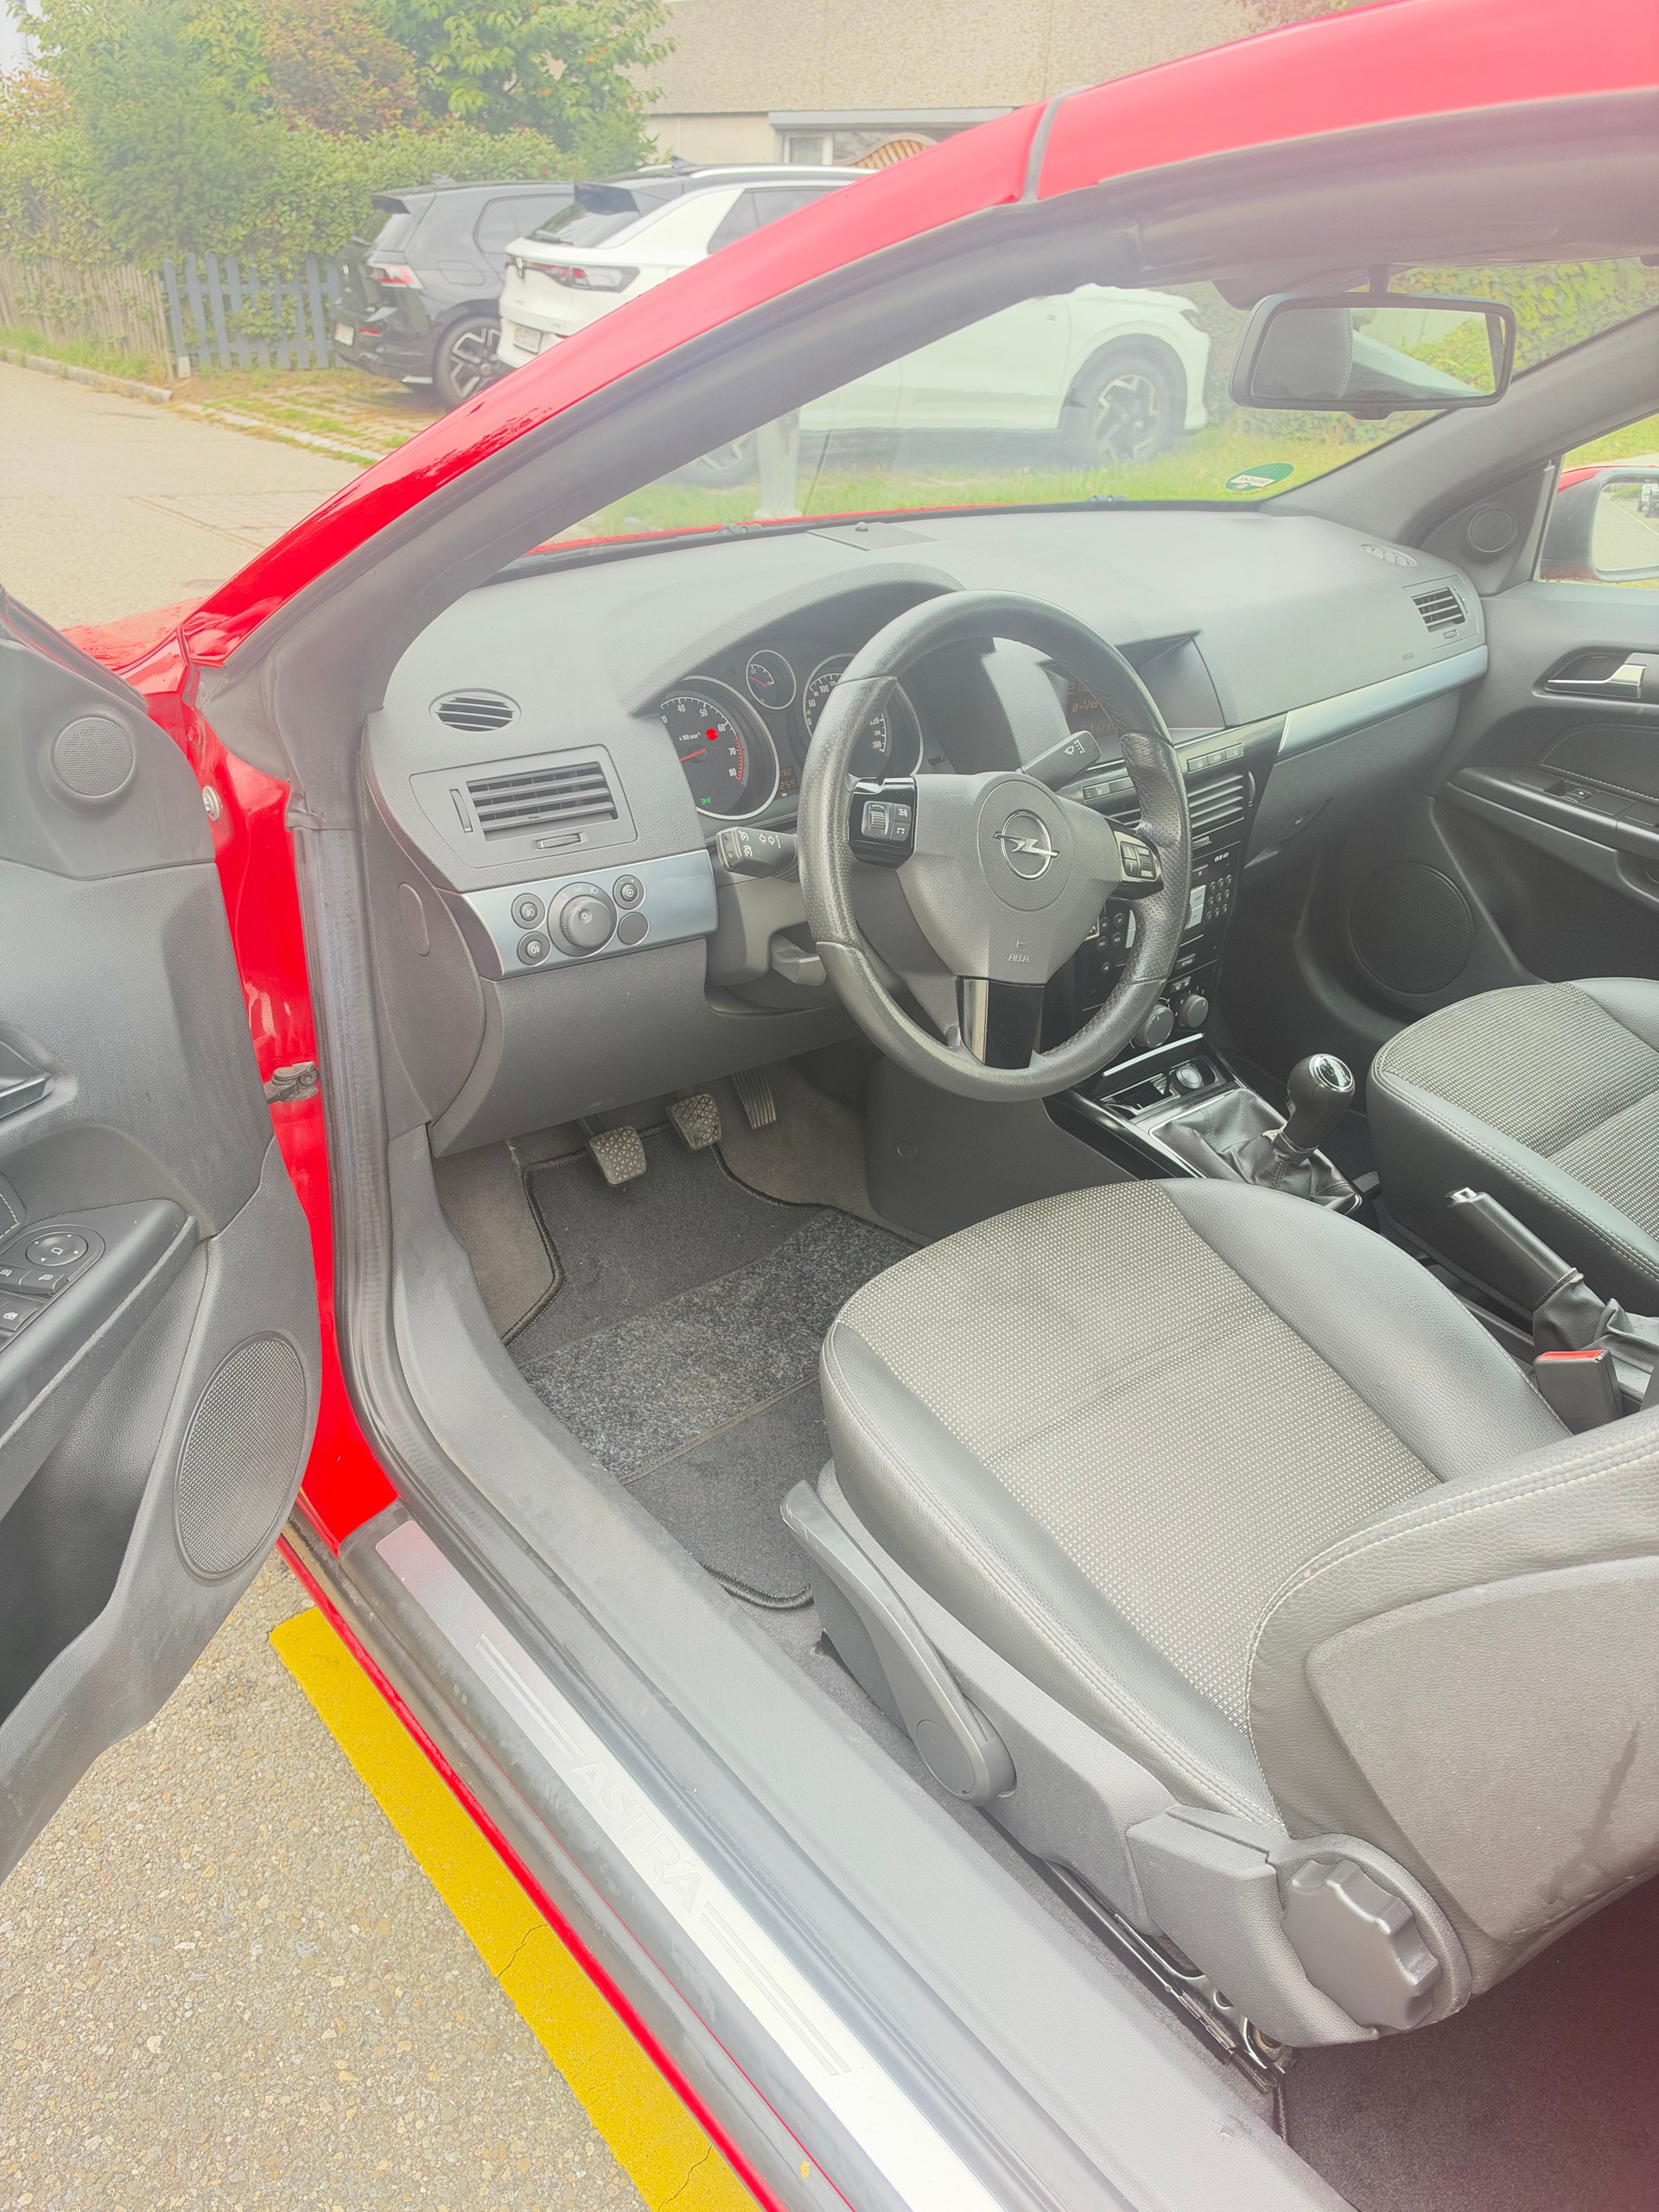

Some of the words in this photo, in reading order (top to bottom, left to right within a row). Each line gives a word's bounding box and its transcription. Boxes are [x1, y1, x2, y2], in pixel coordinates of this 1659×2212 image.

[808, 699, 817, 708] 60
[677, 704, 686, 713] 40
[699, 709, 708, 717] 50
[728, 747, 736, 756] 70
[728, 768, 737, 777] 80
[570, 1762, 703, 1914] ASTRA
